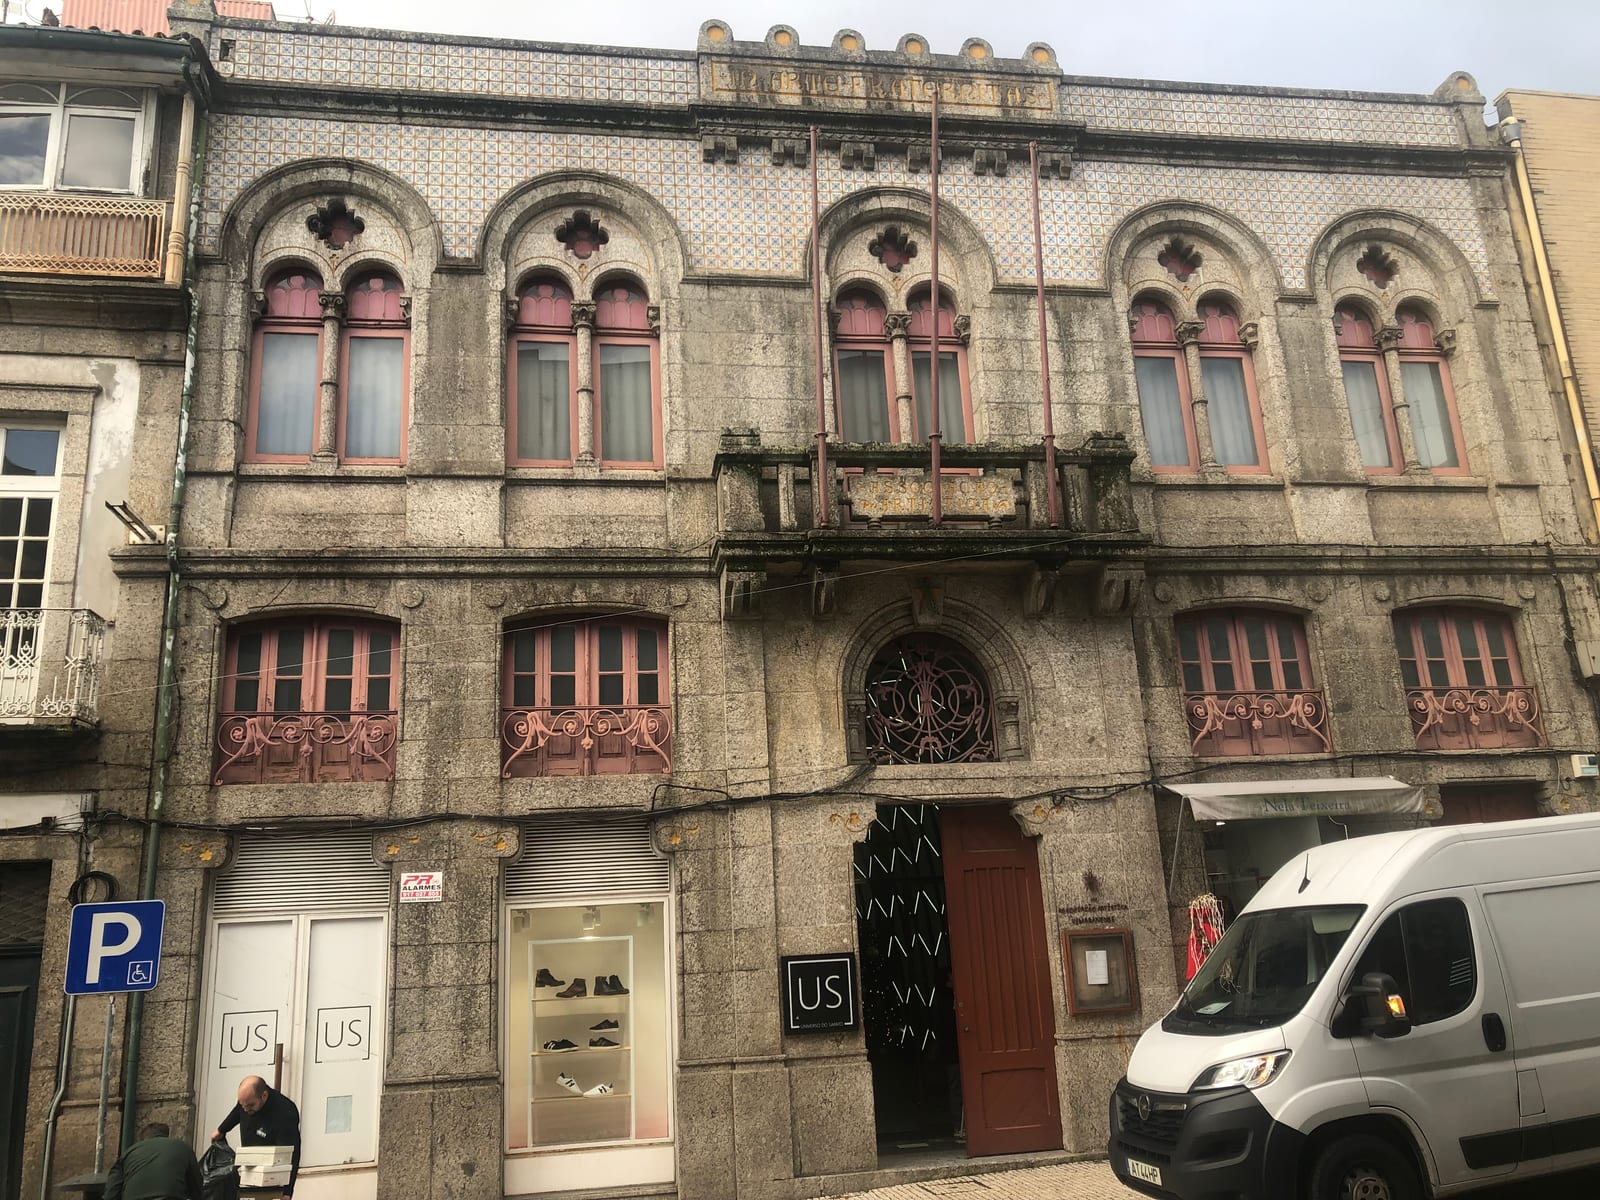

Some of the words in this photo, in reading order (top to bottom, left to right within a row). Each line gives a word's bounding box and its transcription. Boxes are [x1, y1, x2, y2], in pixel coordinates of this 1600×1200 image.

[770, 70, 841, 92] ARTE
[880, 497, 991, 512] ARTITICA
[1263, 797, 1296, 812] Nela
[1296, 795, 1350, 811] Teixeira
[403, 875, 434, 885] PR
[85, 911, 142, 985] P
[798, 975, 842, 1010] US
[230, 1024, 268, 1053] US
[325, 1019, 362, 1048] US
